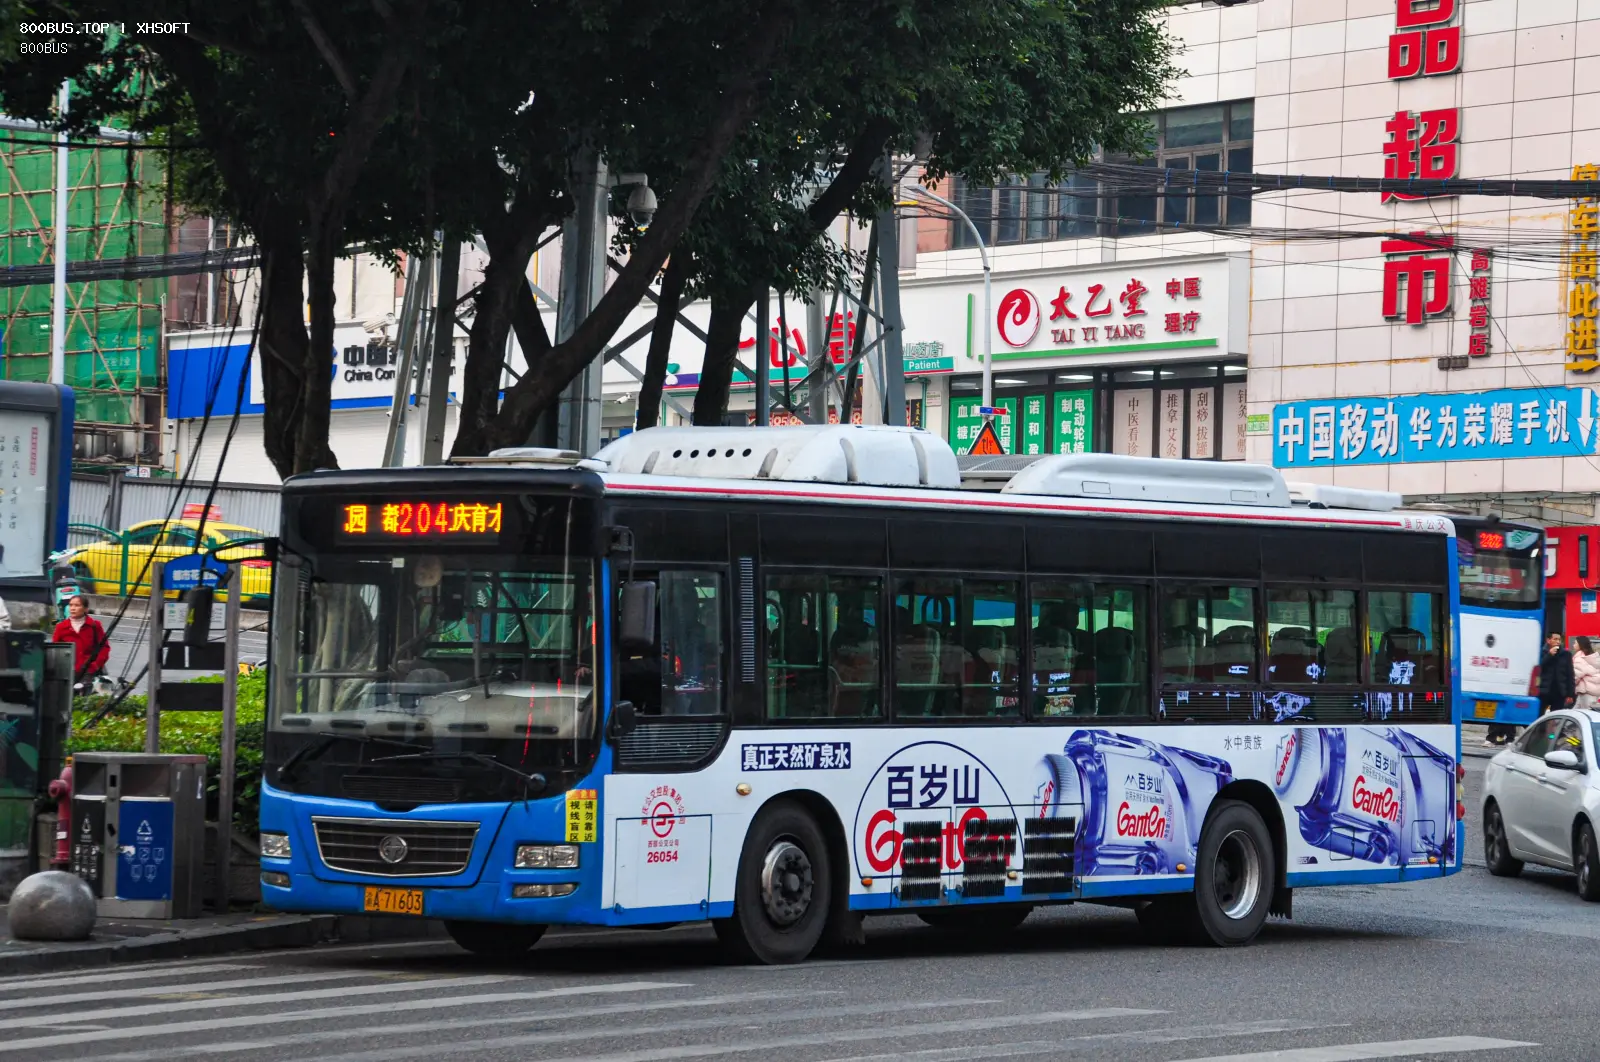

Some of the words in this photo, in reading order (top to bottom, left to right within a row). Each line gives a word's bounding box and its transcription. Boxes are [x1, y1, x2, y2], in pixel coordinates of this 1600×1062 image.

[1165, 277, 1201, 299] 中医
[1051, 328, 1075, 343] TAI
[1081, 326, 1098, 341] YI
[1104, 323, 1145, 340] TANG
[1164, 311, 1200, 333] 理疗
[344, 369, 373, 383] China
[908, 359, 941, 371] Patient
[1166, 393, 1179, 423] 推拿
[1196, 392, 1209, 422] 刮痧
[1060, 398, 1073, 453] 制氧机
[1073, 397, 1086, 453] 电动轮椅
[1127, 397, 1140, 456] 中医看诊
[1278, 402, 1400, 462] 中国移动
[1409, 399, 1571, 451] 华为荣耀手机
[1165, 427, 1178, 457] 艾灸
[1196, 426, 1209, 456] 拔罐
[399, 502, 448, 533] 204
[743, 744, 849, 770] 真正天然矿泉水
[1224, 735, 1263, 751] 水中贵族
[1375, 750, 1397, 777] 百岁山
[886, 763, 981, 809] 百岁山
[1138, 772, 1162, 794] 百岁山
[569, 800, 581, 842] 视线盲区
[584, 800, 594, 842] 请勿靠近
[647, 850, 679, 864] 26054
